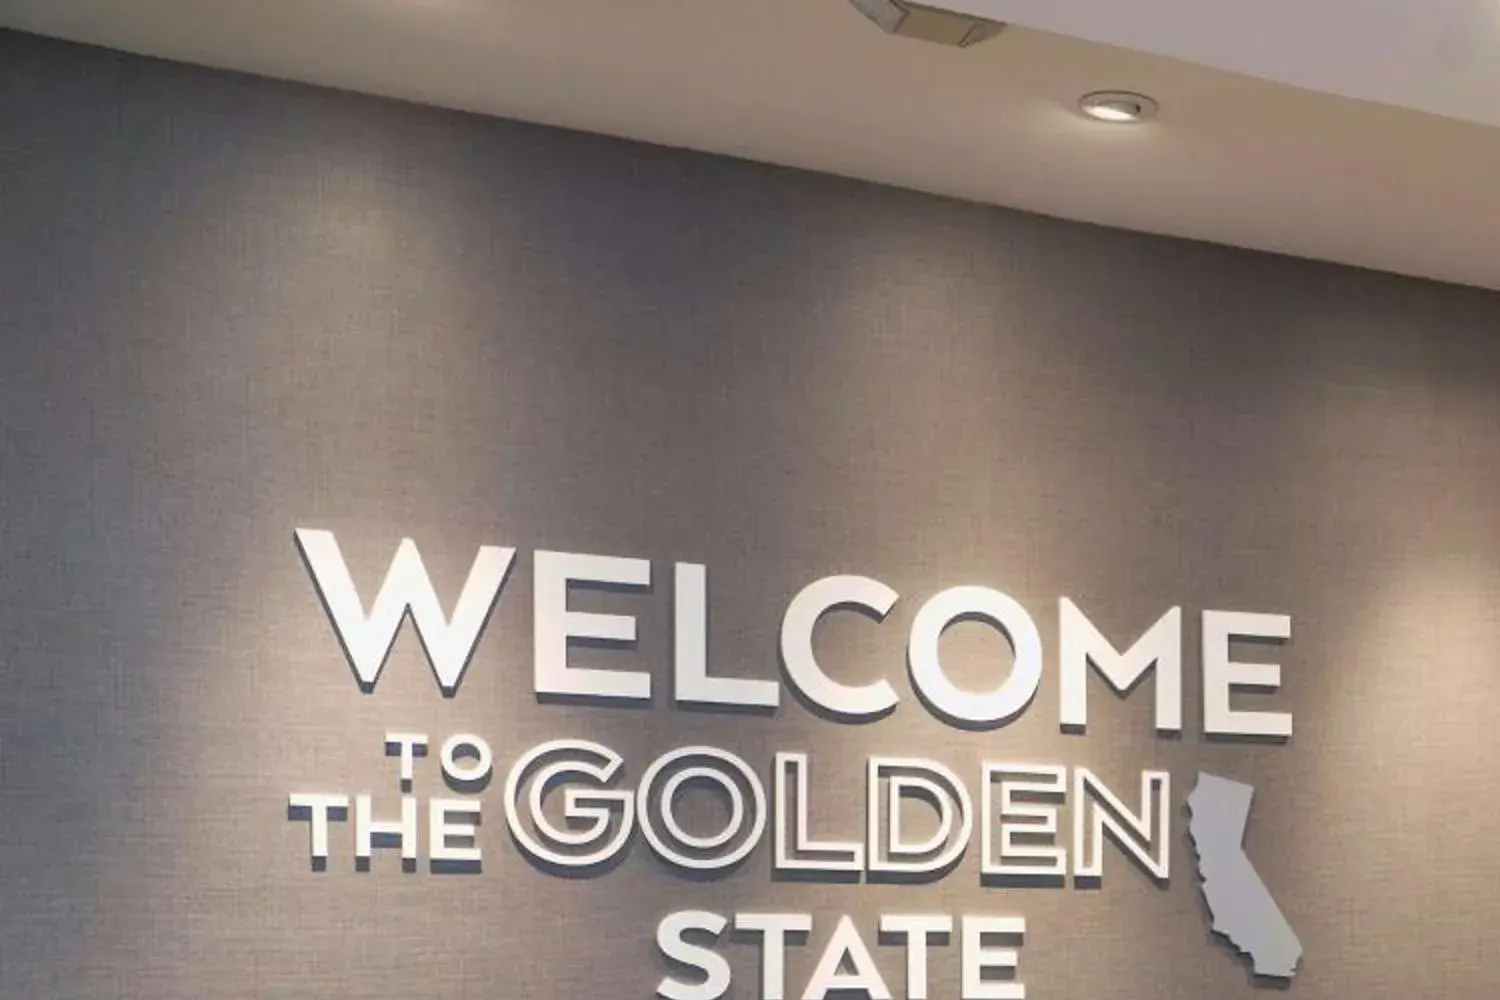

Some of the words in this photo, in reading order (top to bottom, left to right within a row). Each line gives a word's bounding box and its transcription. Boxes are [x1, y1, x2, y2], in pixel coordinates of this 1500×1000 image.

[294, 527, 1293, 736] WELCOME
[288, 792, 483, 866] THE
[504, 738, 1170, 881] GOLDEN
[386, 732, 492, 790] TO
